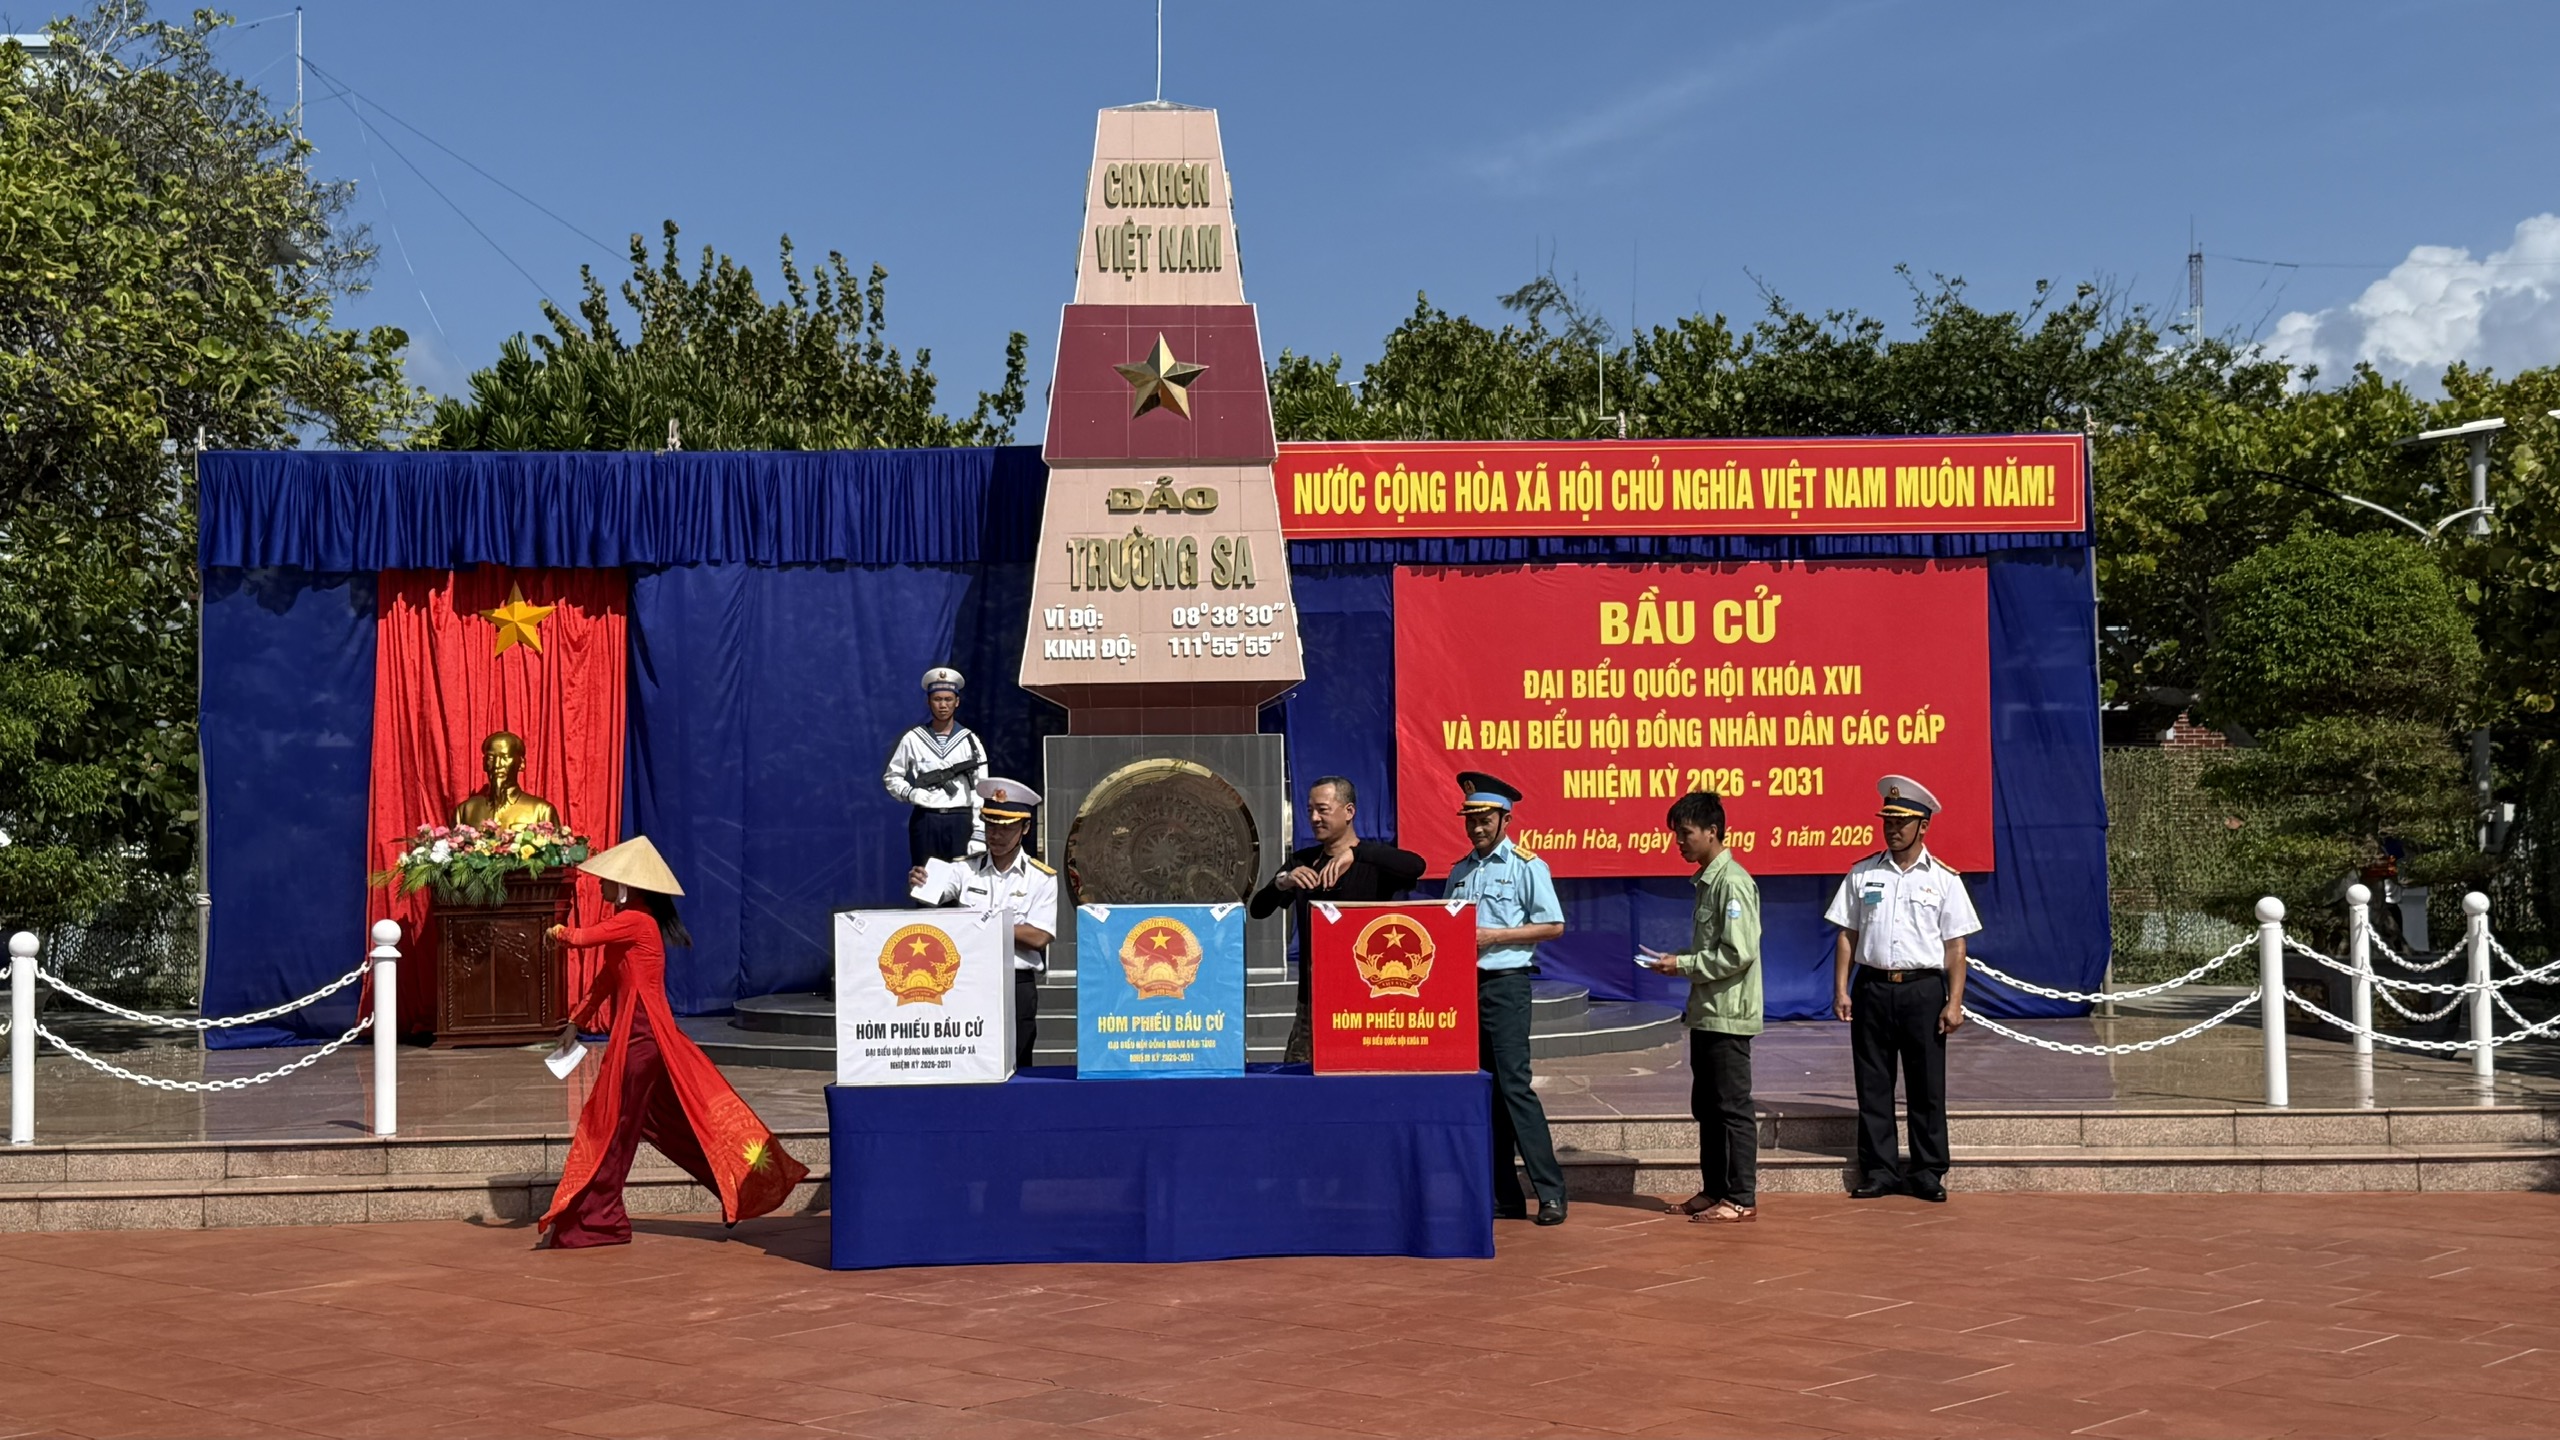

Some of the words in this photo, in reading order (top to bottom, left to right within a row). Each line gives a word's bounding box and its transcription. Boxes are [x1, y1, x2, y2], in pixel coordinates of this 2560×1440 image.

[1104, 163, 1210, 208] CHXHCN
[1096, 216, 1151, 281] VIỆT
[1159, 224, 1222, 273] NAM
[1106, 476, 1219, 515] ĐẢO
[1294, 463, 1365, 515] NƯỚC
[1375, 463, 1446, 523] CỘNG
[1455, 461, 1508, 513] HÒA
[1516, 462, 1551, 512] XÃ
[1559, 461, 1602, 522] HỘI
[1612, 455, 1664, 511] CHỦ
[1673, 460, 1754, 510] NGHĨA
[1761, 459, 1816, 519] VIỆT
[1825, 466, 1886, 508] NAM
[1895, 457, 1974, 507] MUÔN
[1984, 457, 2055, 506] NĂM!
[1067, 525, 1198, 592] TRƯỜNG
[1212, 535, 1256, 591] SA
[1044, 604, 1066, 629] VĨ
[1069, 604, 1104, 633] ĐỘ:
[1600, 586, 1695, 644] BẦU
[1713, 584, 1782, 644] CỬ
[1044, 639, 1096, 659] KINH
[1101, 634, 1137, 664] ĐỘ:
[1524, 669, 1564, 705] ĐẠI
[1571, 657, 1625, 699] BIỂU
[1633, 658, 1697, 701] QUỐC
[1704, 661, 1744, 703] HỘI
[1751, 660, 1817, 697] KHÓA
[1823, 665, 1861, 695] XVI
[1443, 714, 1474, 750] VÀ
[1480, 720, 1520, 756] ĐẠI
[1528, 708, 1582, 750] BIỂU
[1590, 713, 1629, 755] HỘI
[1636, 709, 1702, 748] ĐỒNG
[1709, 711, 1777, 748] NHÂN
[1784, 710, 1834, 747] DÂN
[1841, 709, 1889, 746] CÁC
[1897, 704, 1946, 745] CẤP
[1563, 763, 1642, 805] NHIỆM
[1649, 763, 1679, 798] KỲ
[1686, 768, 1744, 796] 2026
[1769, 767, 1823, 796] 2031
[1519, 829, 1577, 850] Khánh
[1582, 828, 1622, 852] Hòa,
[1628, 827, 1674, 854] ngày
[1722, 826, 1756, 852] áng
[1771, 827, 1782, 847] 3
[1787, 826, 1825, 846] năm
[1830, 825, 1873, 846] 2026
[856, 1020, 886, 1040] HÒM
[891, 1017, 930, 1039] PHIẾU
[934, 1016, 960, 1038] BẦU
[965, 1015, 984, 1037] CỬ
[1098, 1012, 1129, 1033] HÒM
[1132, 1010, 1171, 1032] PHIẾU
[1175, 1010, 1202, 1032] BẦU
[1206, 1009, 1225, 1031] CỬ
[1333, 1009, 1362, 1029] HÒM
[1366, 1007, 1404, 1029] PHIẾU
[1408, 1006, 1435, 1029] BẦU
[1438, 1007, 1458, 1028] CỬ
